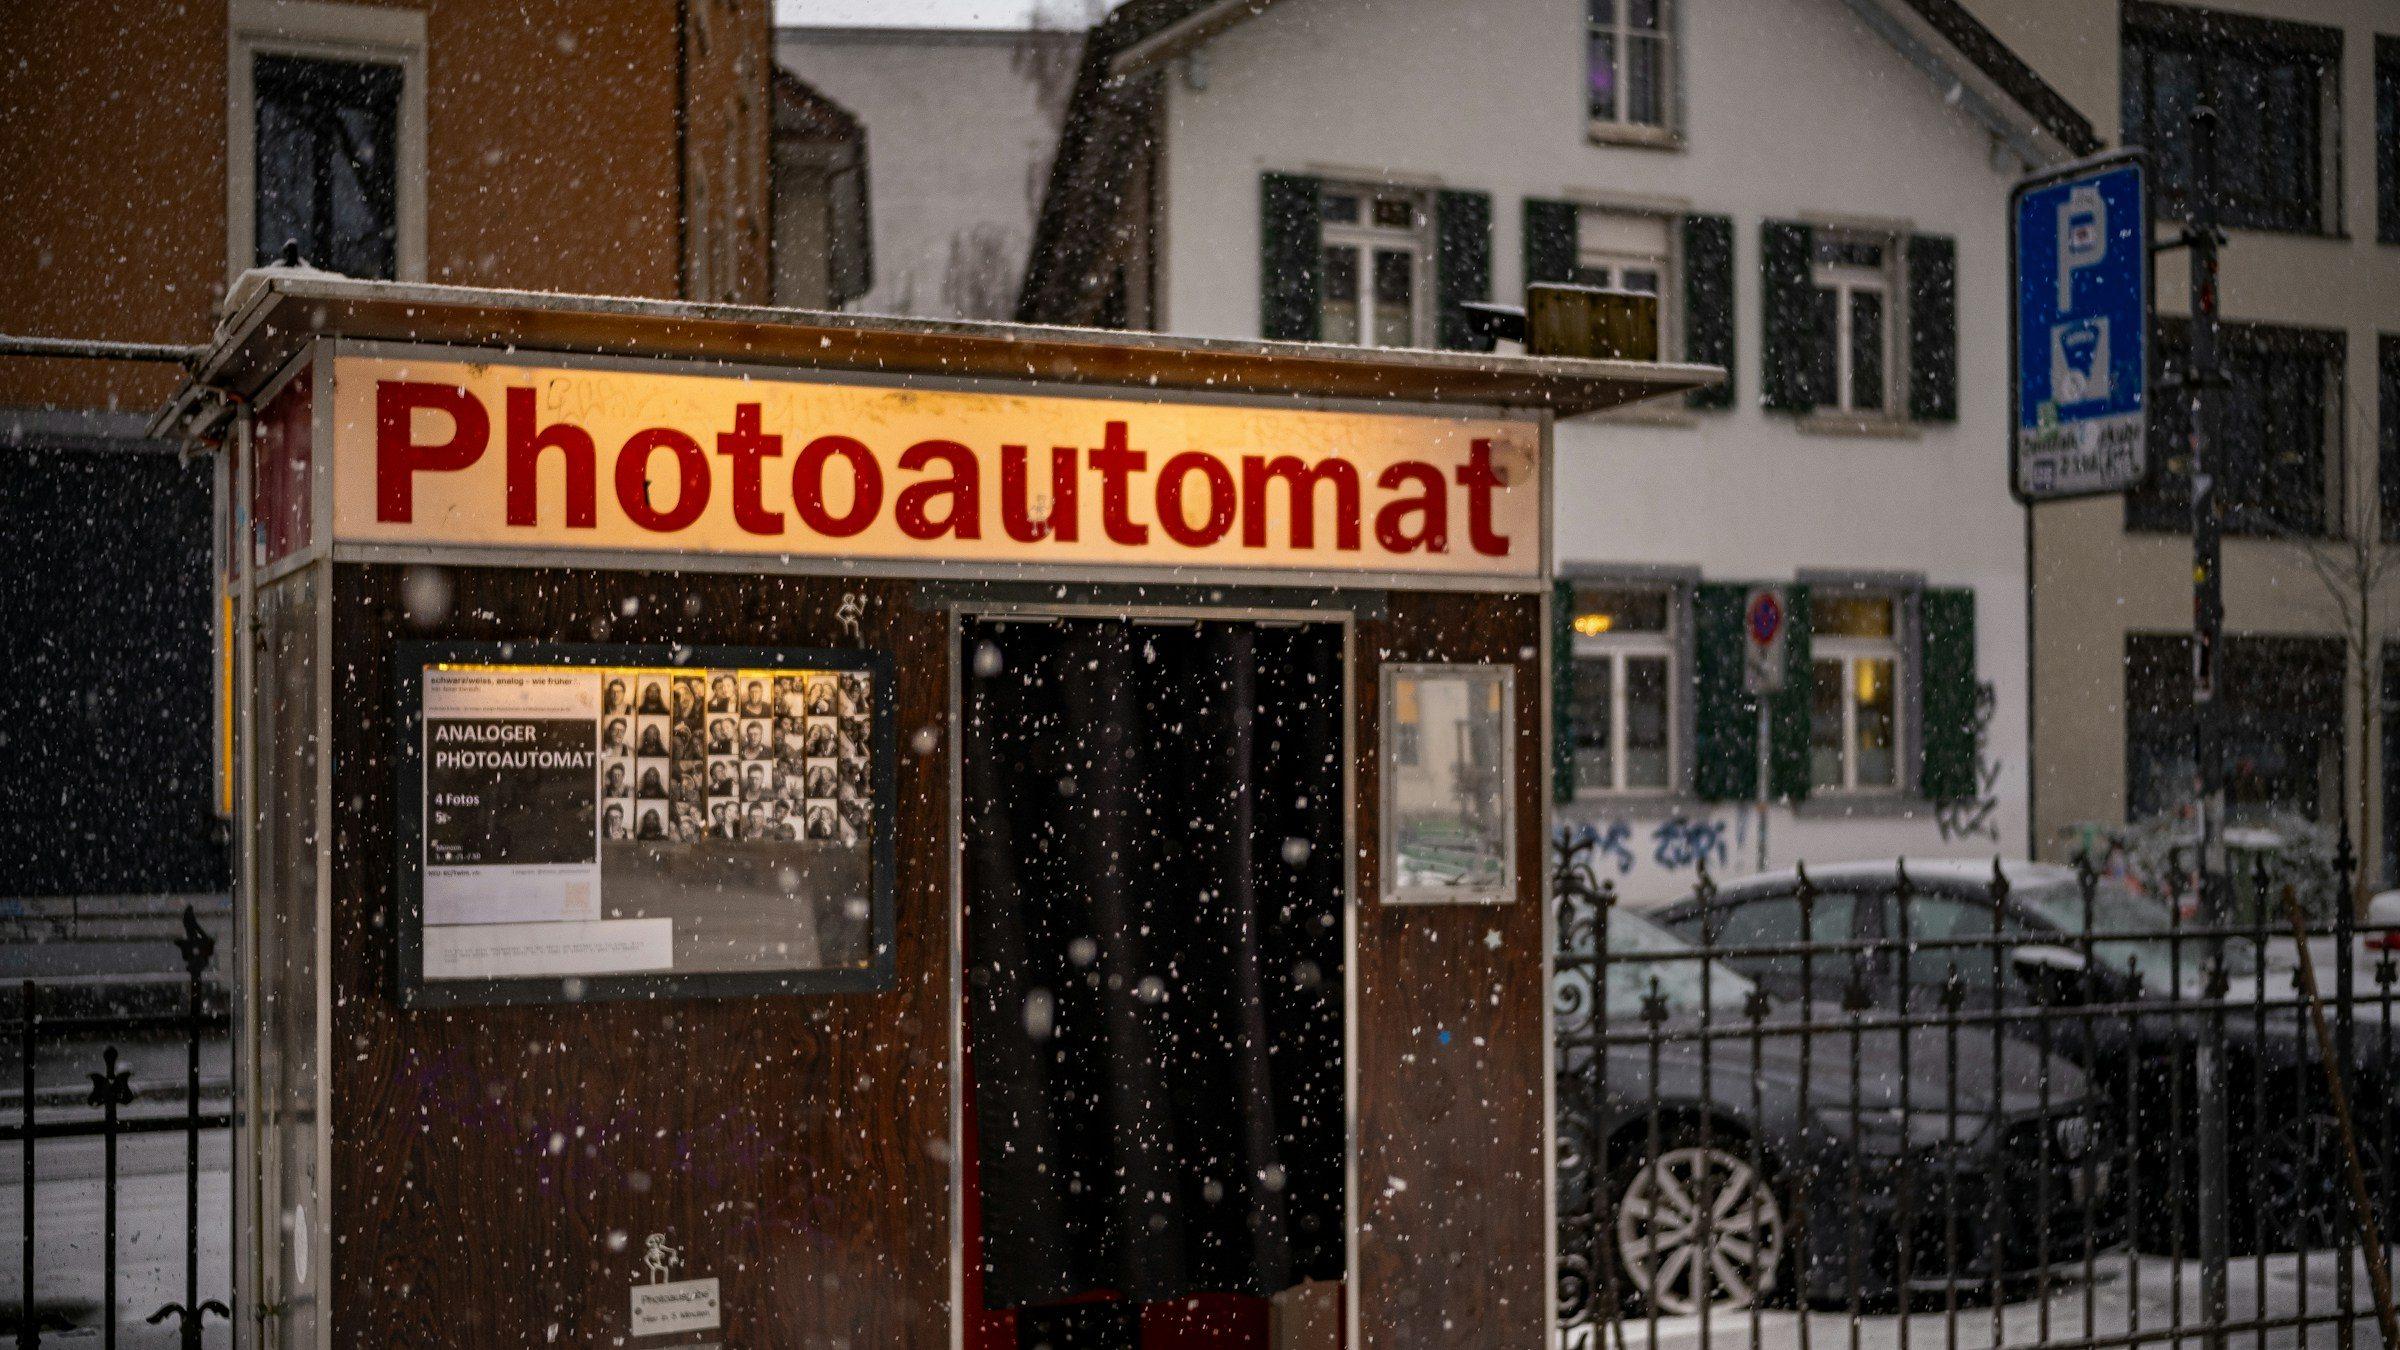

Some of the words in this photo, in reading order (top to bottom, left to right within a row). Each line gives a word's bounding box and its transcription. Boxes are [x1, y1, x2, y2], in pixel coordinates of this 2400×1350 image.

[376, 379, 1510, 557] Photoautomat
[496, 677, 524, 687] analog
[532, 677, 546, 686] wie
[435, 724, 537, 742] ANALOGER
[435, 751, 595, 768] PHOTOAUTOMAT
[435, 793, 443, 806] 4
[446, 793, 480, 807] Fotos
